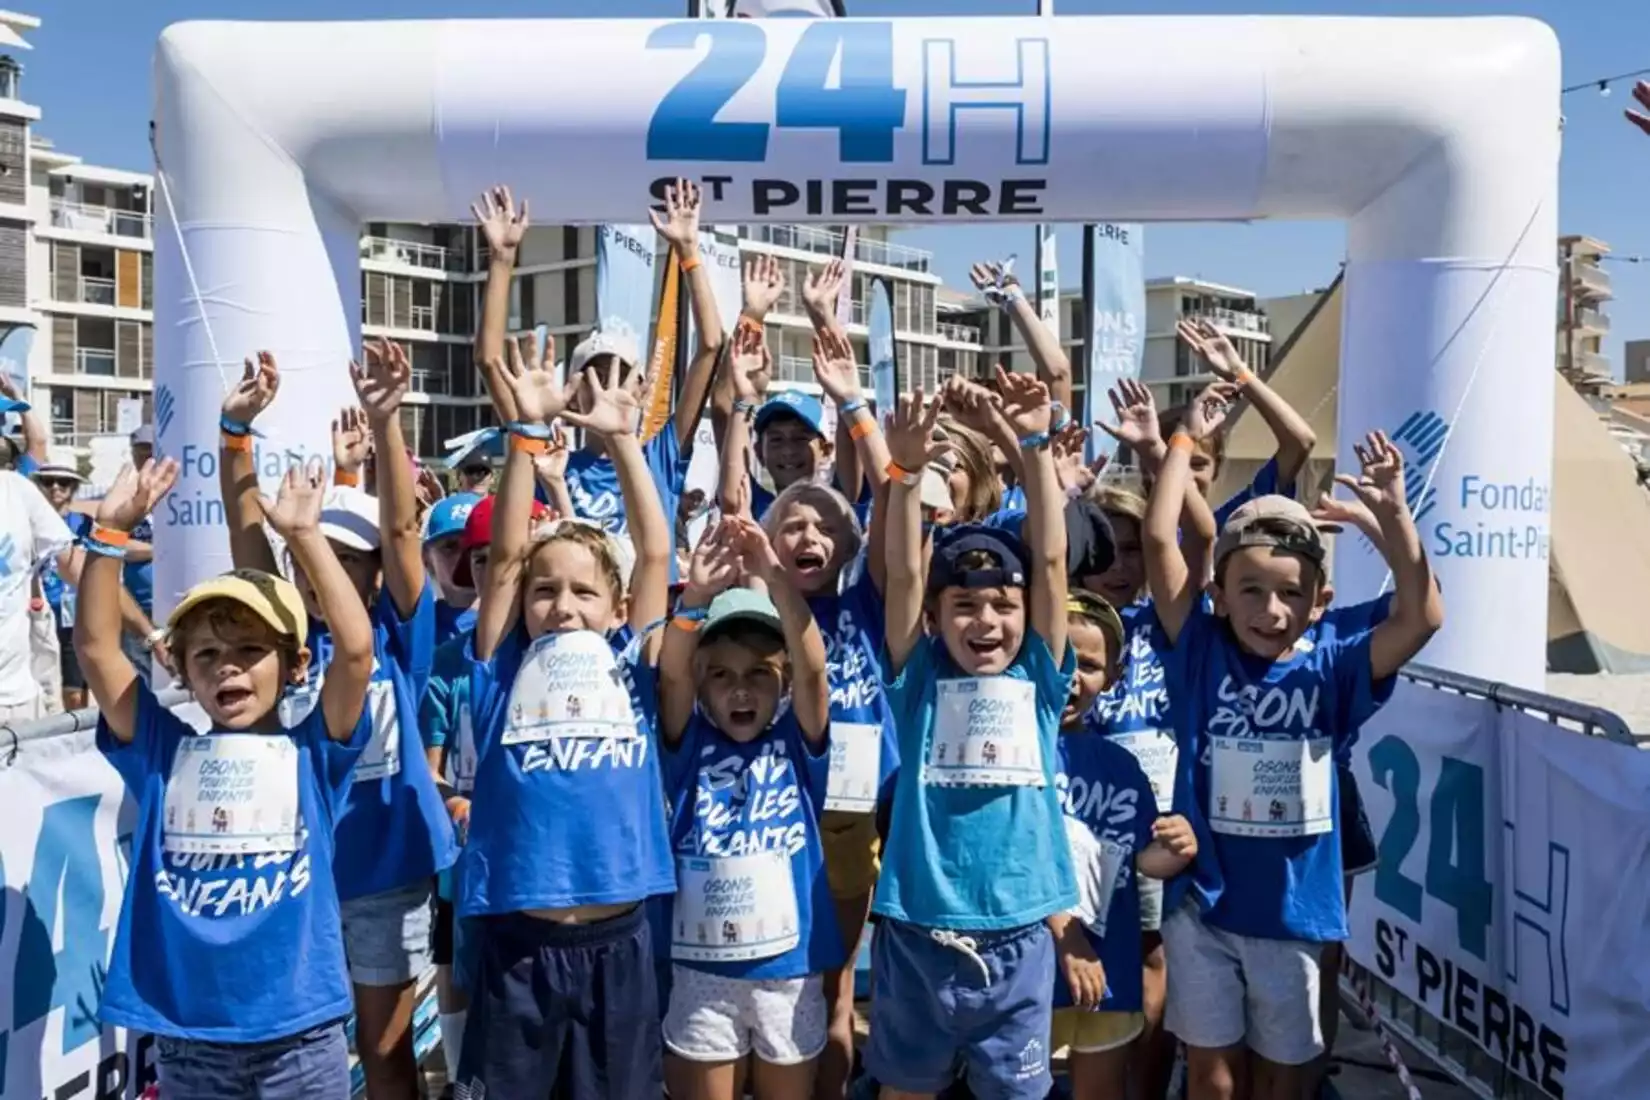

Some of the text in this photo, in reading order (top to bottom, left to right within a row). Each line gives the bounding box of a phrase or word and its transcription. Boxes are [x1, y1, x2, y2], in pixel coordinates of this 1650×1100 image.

[645, 20, 1050, 166] 24H
[752, 179, 1047, 215] PIERRE
[750, 785, 801, 824] LES
[1368, 732, 1570, 1017] 24H
[1375, 918, 1568, 1100] ST PIERRE
